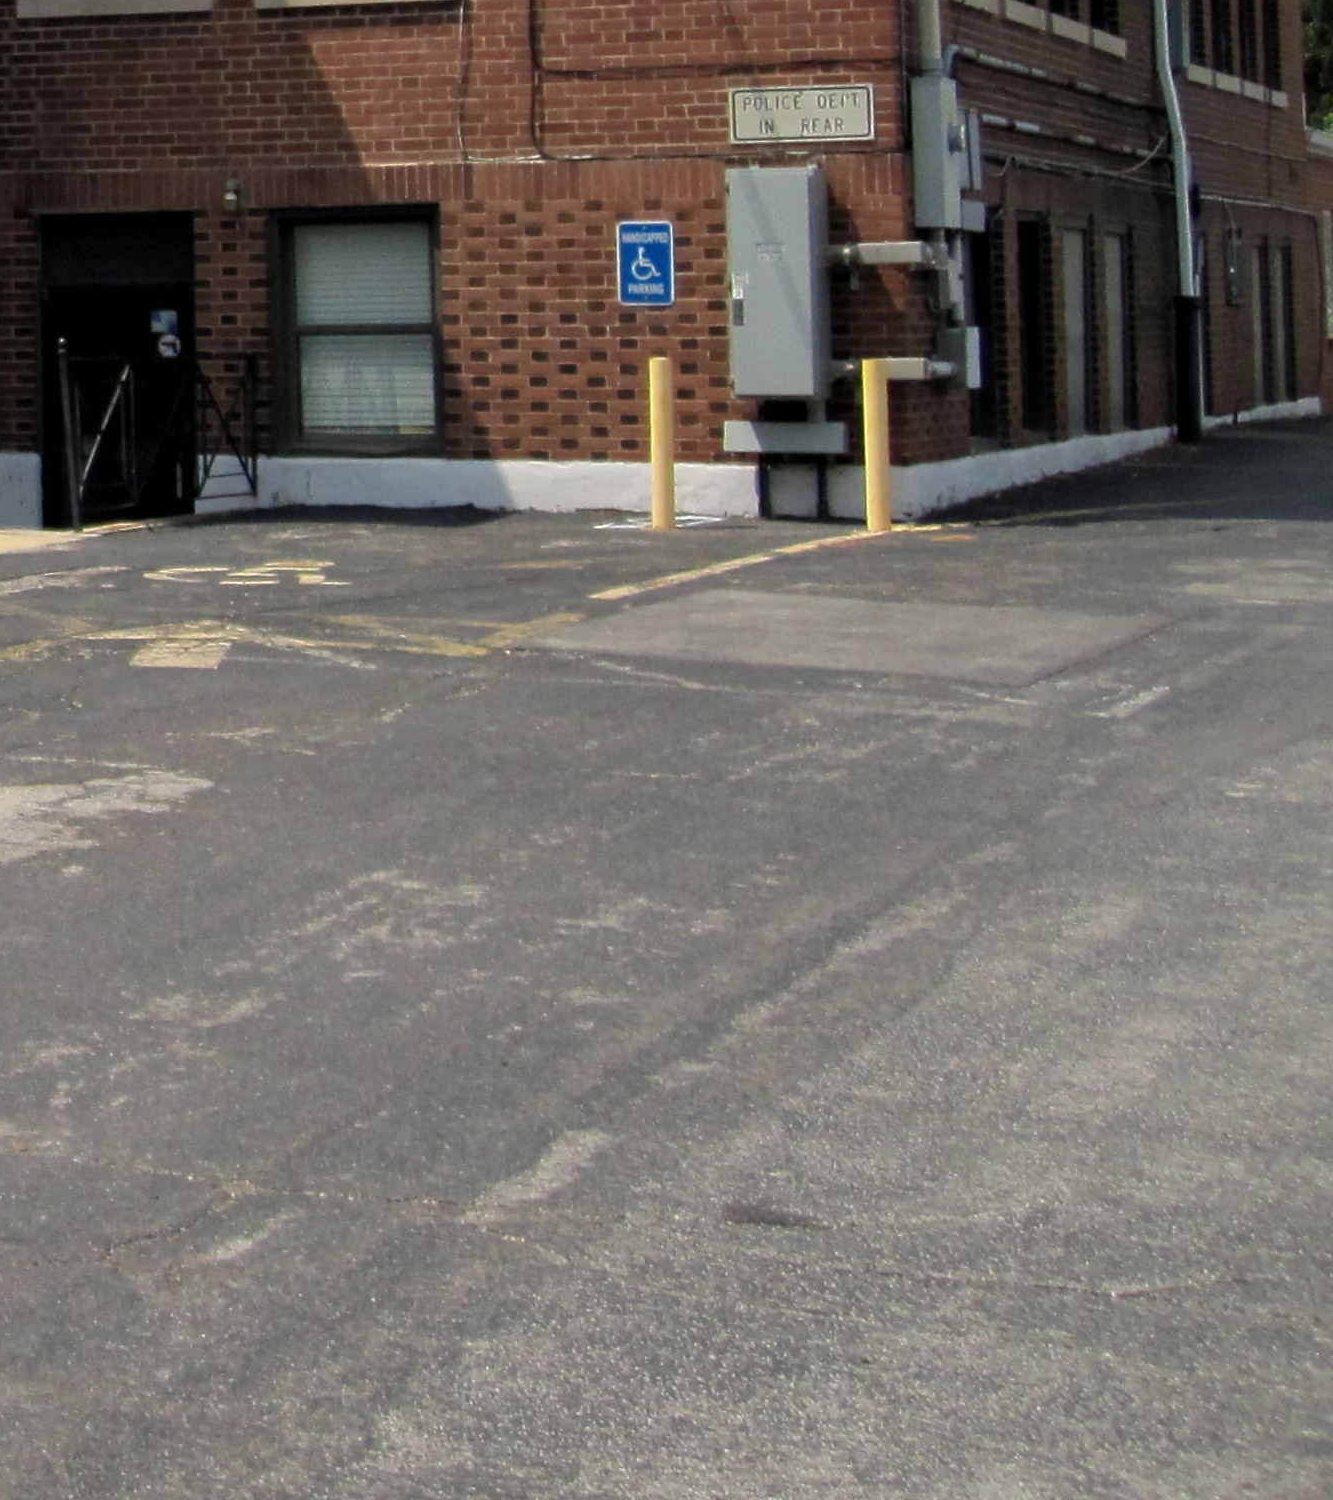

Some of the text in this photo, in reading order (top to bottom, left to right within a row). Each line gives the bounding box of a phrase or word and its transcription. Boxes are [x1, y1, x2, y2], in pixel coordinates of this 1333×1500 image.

[742, 94, 802, 111] POLICE
[759, 117, 845, 134] IN REAR
